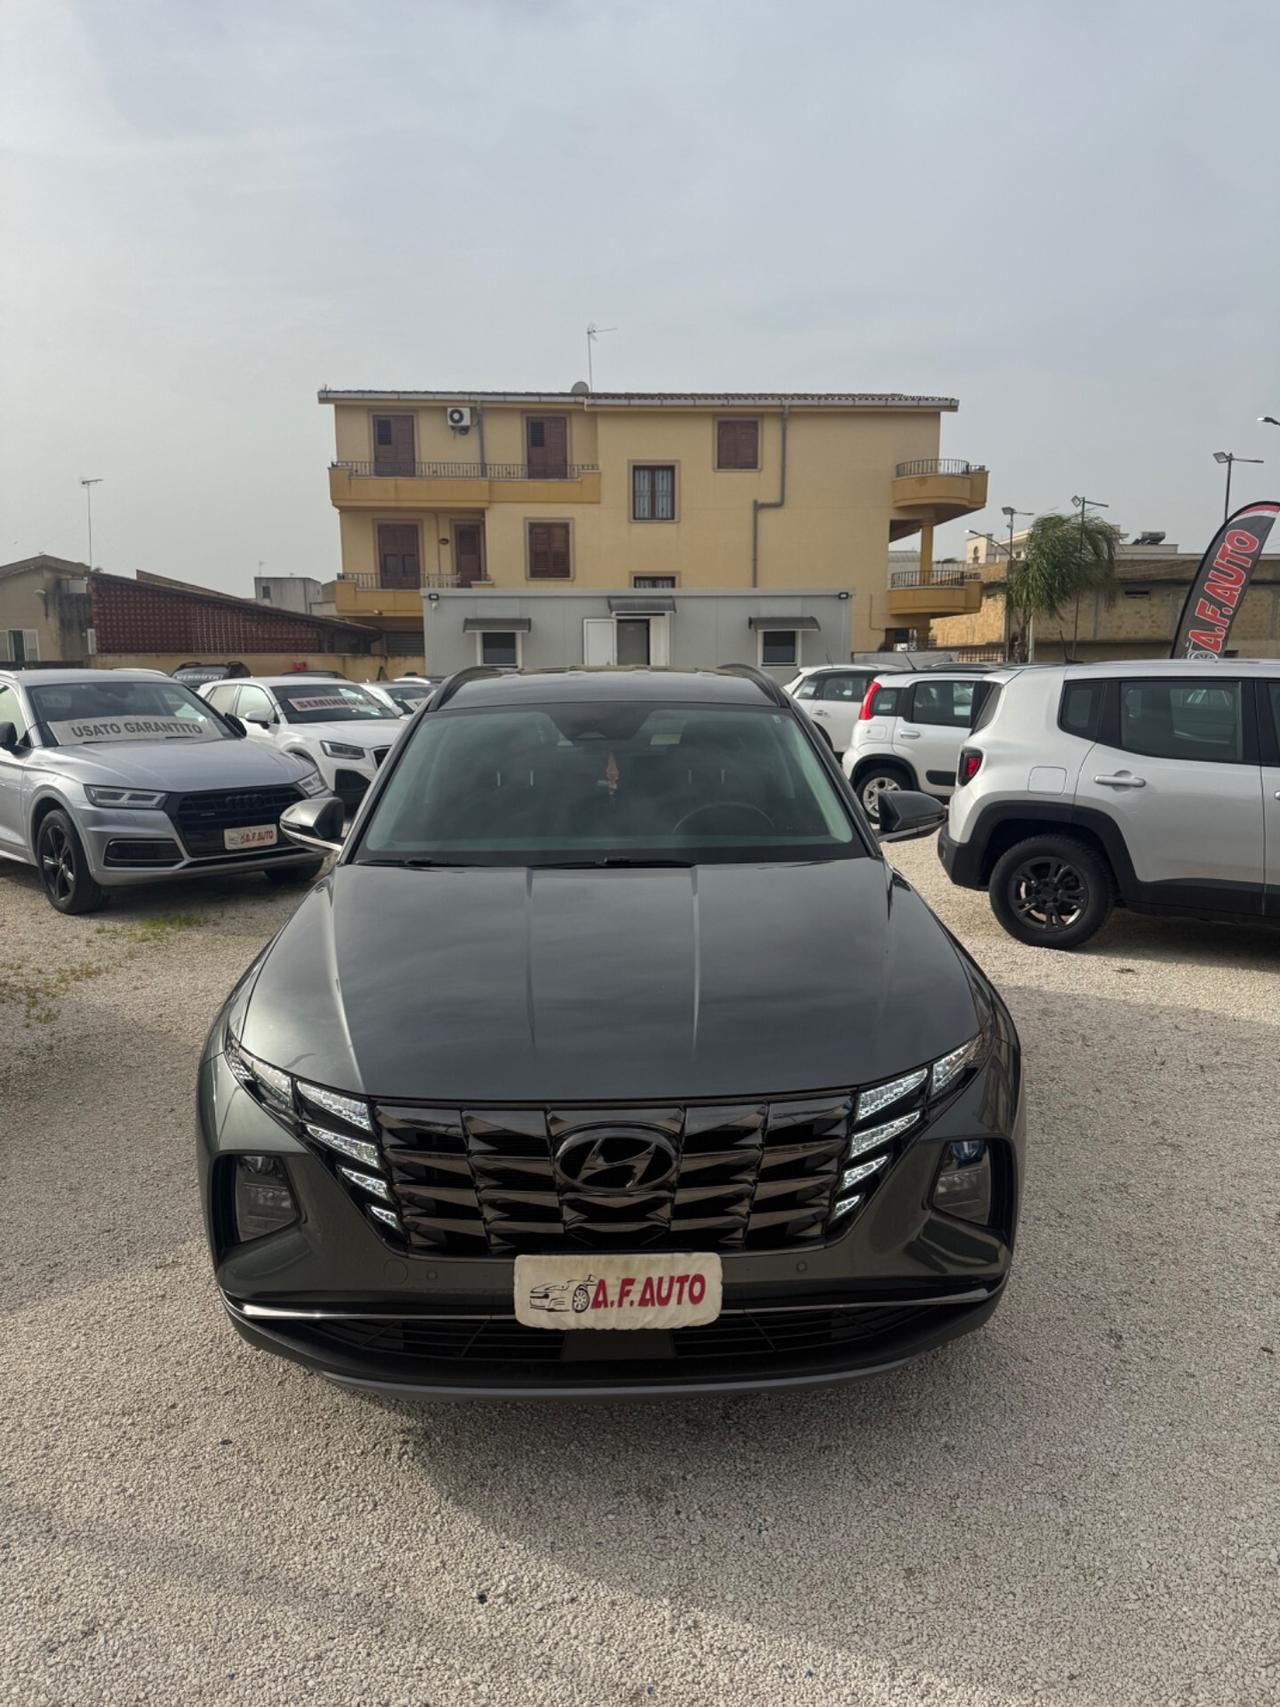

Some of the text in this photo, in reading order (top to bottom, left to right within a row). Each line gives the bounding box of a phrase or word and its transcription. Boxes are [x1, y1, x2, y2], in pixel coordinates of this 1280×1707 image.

[297, 698, 374, 709] SEMINUO
[71, 721, 203, 738] USATO GARANTITO
[590, 1273, 706, 1309] A.F.AUTO
